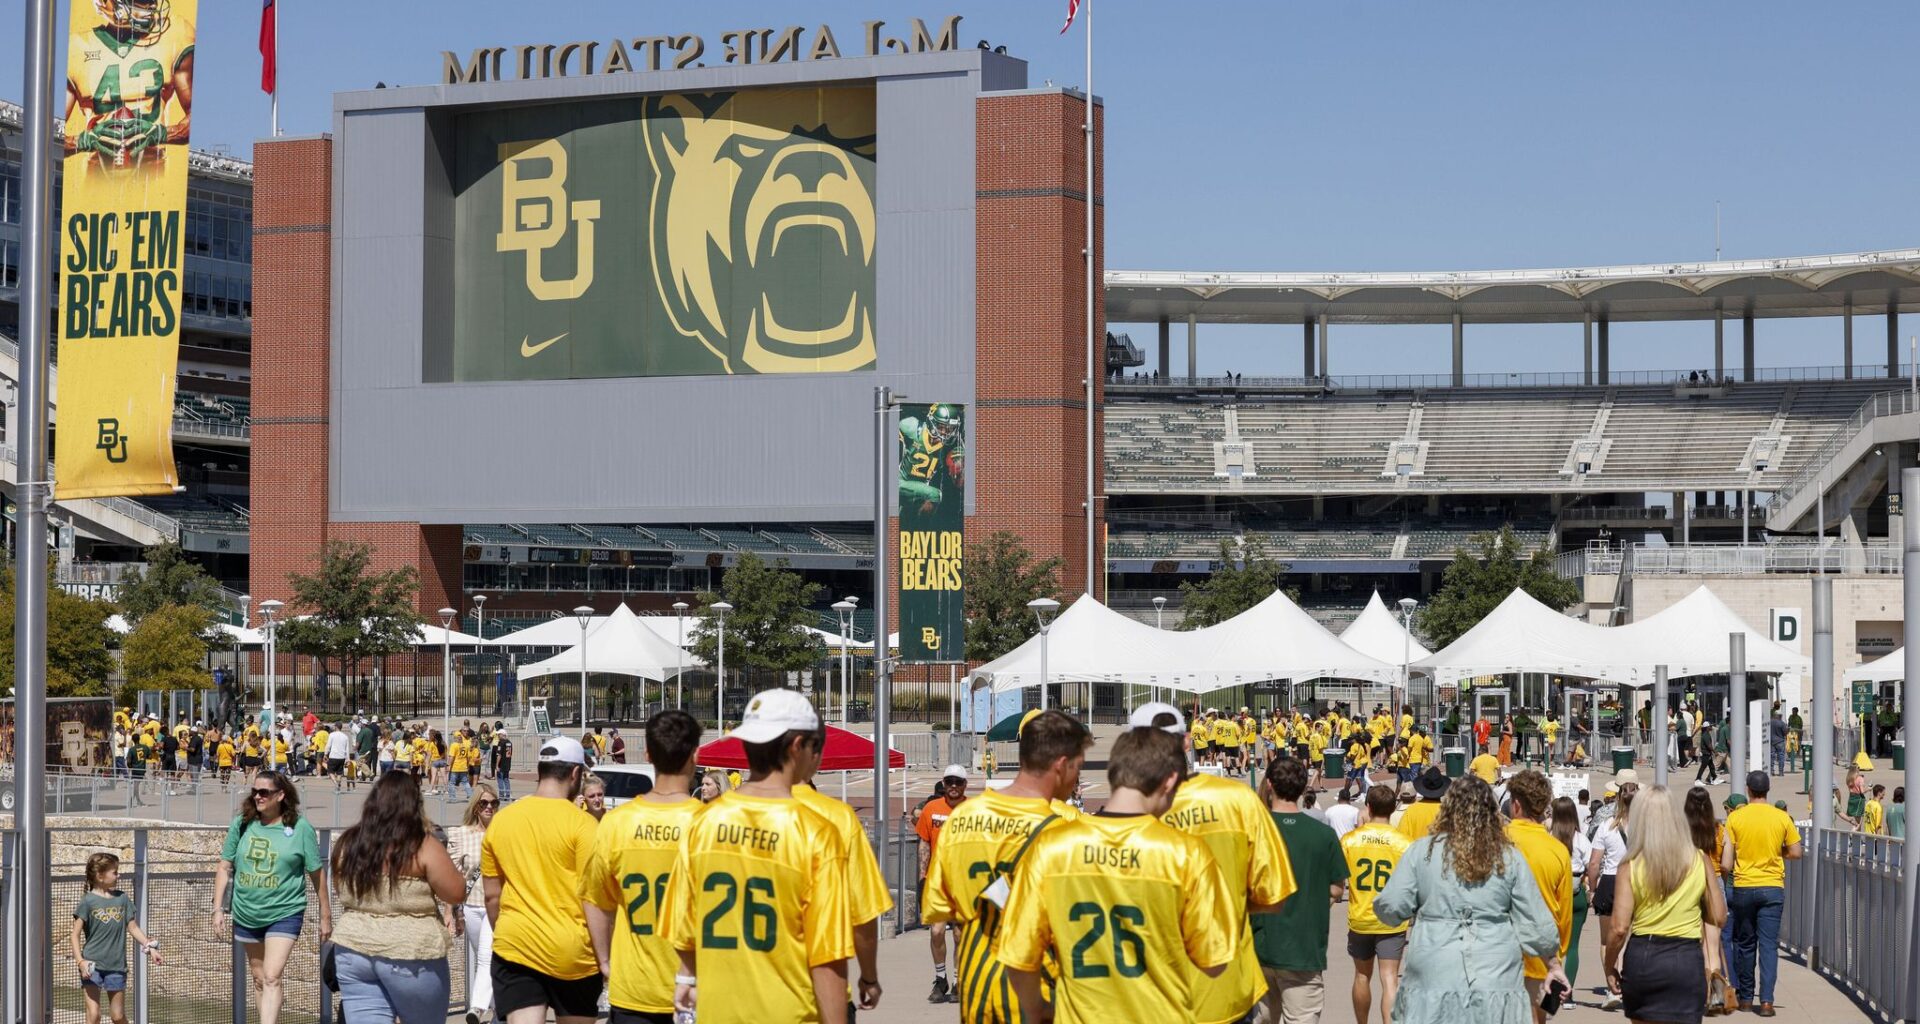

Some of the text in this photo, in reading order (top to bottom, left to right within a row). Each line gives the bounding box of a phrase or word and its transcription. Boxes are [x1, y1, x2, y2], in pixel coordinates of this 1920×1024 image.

[93, 59, 164, 123] 43
[496, 137, 601, 301] BU
[67, 212, 118, 274] SIC
[65, 271, 178, 340] BEARS
[96, 418, 128, 464] BU
[910, 452, 939, 479] 21
[900, 531, 962, 559] BAYLOR
[902, 558, 962, 591] BEARS
[922, 627, 941, 651] BU
[1778, 615, 1797, 642] D
[634, 824, 681, 842] AREGO
[1165, 805, 1219, 829] SWELL
[716, 823, 780, 852] DUFFER
[244, 836, 279, 875] BU
[1084, 845, 1141, 869] DUSEK
[239, 871, 280, 889] BAYLOR
[1356, 857, 1393, 893] 26
[701, 871, 778, 953] 26
[1068, 901, 1148, 980] 26
